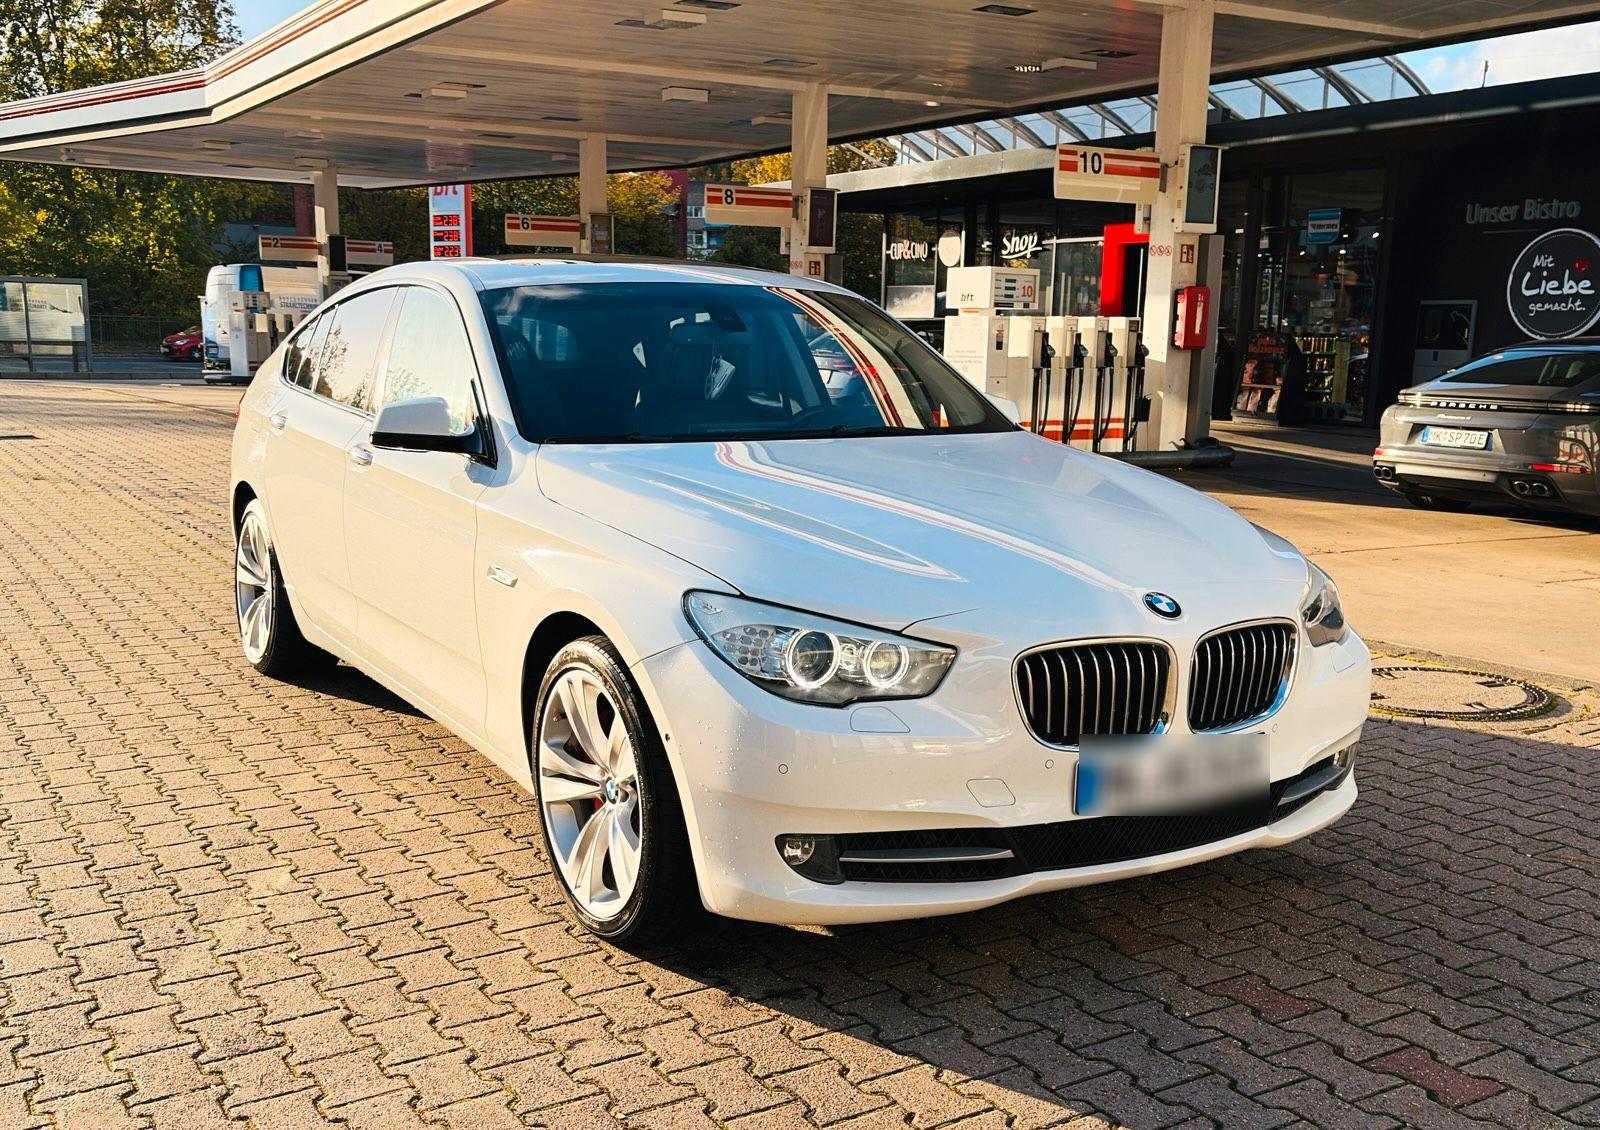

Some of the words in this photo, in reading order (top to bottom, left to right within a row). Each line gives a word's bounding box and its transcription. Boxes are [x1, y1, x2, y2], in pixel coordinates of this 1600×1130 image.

[1079, 151, 1102, 174] 10
[724, 188, 734, 205] 8
[1466, 203, 1520, 224] Unser
[1523, 198, 1581, 220] Bistro
[521, 217, 530, 230] 6
[272, 238, 280, 248] 2
[376, 243, 383, 253] 4
[1001, 232, 1040, 259] Shop
[1532, 254, 1555, 268] Mit
[1521, 269, 1595, 297] Liebe
[960, 293, 974, 302] bft
[1021, 285, 1033, 298] 10
[1528, 297, 1586, 316] gemacht.
[1430, 401, 1498, 410] PORSCHE
